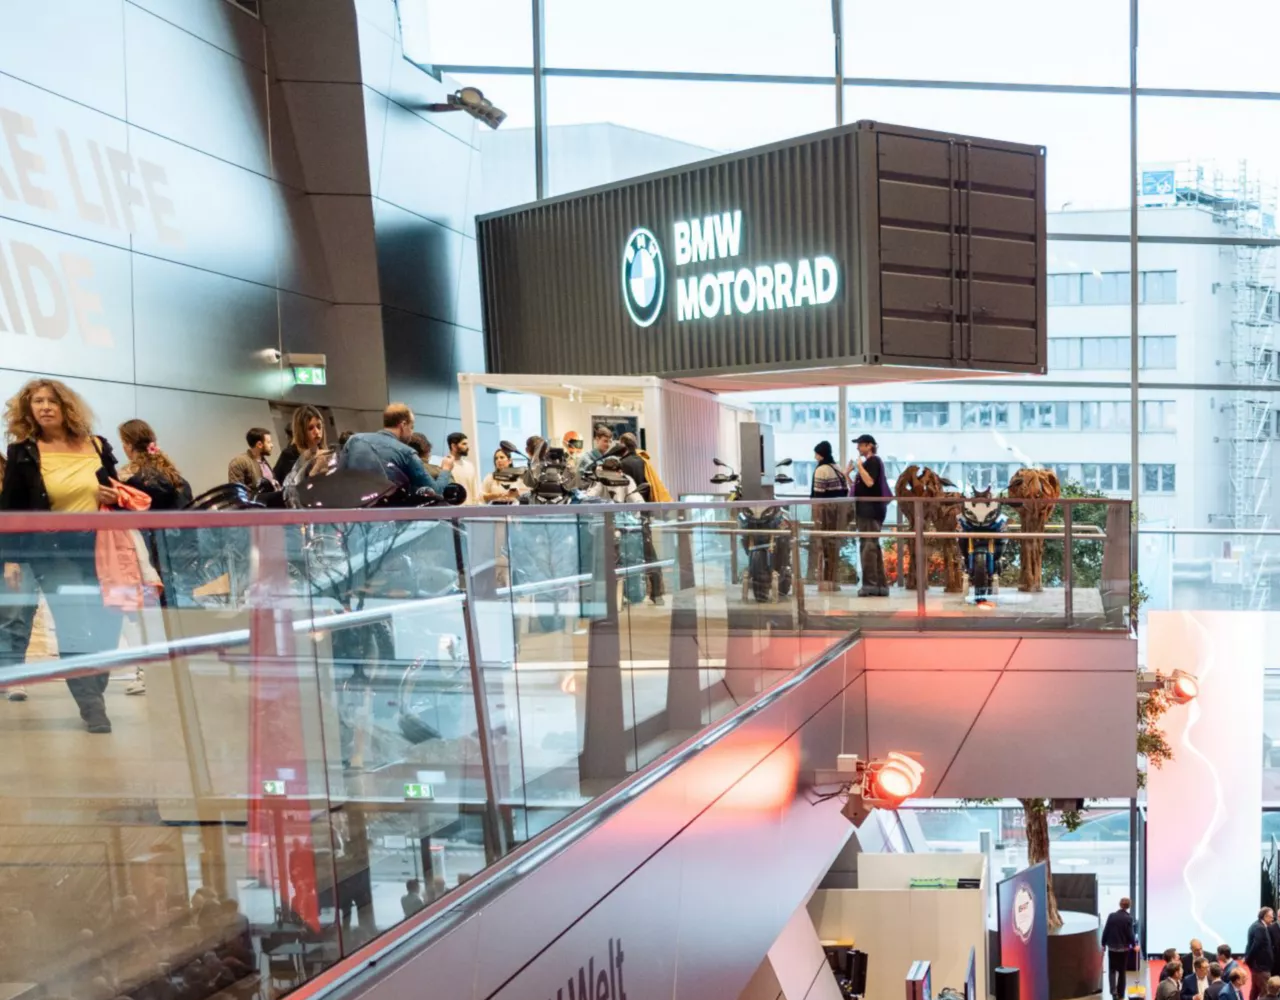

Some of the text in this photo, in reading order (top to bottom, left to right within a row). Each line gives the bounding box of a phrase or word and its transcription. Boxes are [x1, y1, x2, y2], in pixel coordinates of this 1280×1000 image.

[0, 107, 189, 249] E LIFE
[674, 210, 741, 266] BMW
[0, 238, 116, 348] IDE
[677, 256, 838, 322] MOTORRAD
